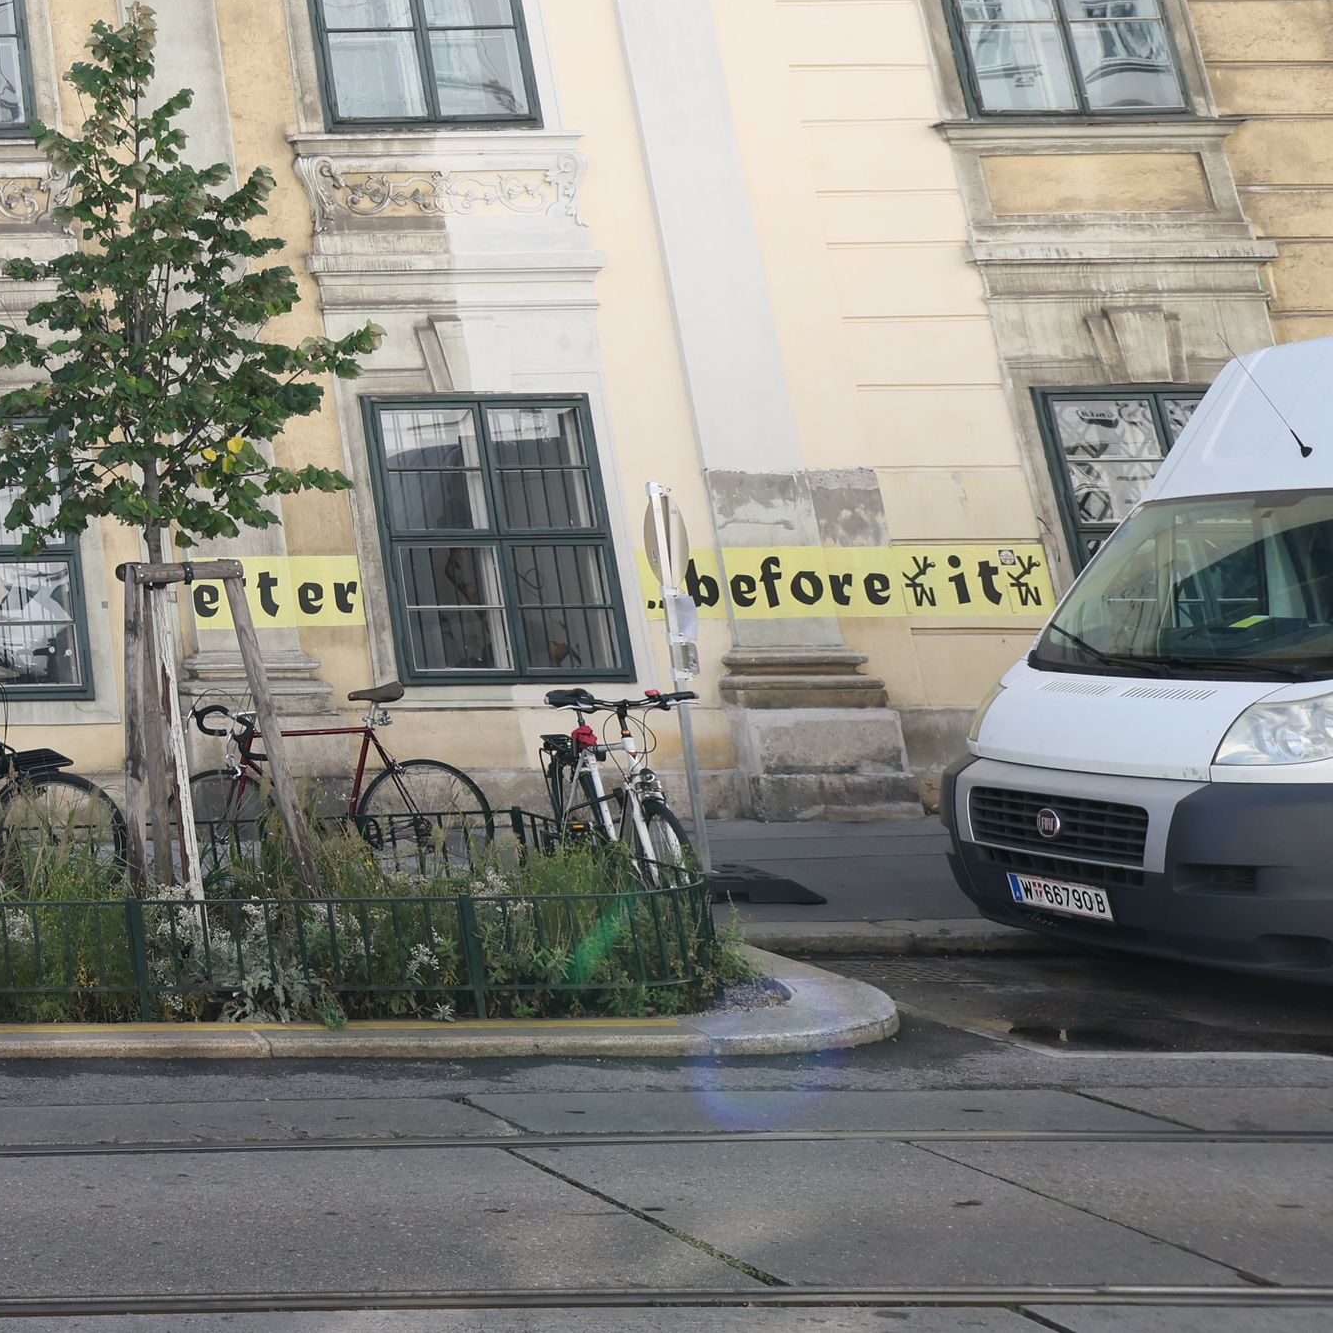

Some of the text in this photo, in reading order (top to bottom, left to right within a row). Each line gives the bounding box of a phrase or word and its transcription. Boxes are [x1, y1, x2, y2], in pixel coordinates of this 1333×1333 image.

[192, 571, 358, 618] eter
[947, 554, 1003, 606] it
[1041, 817, 1055, 831] FIAT
[1019, 879, 1033, 900] W
